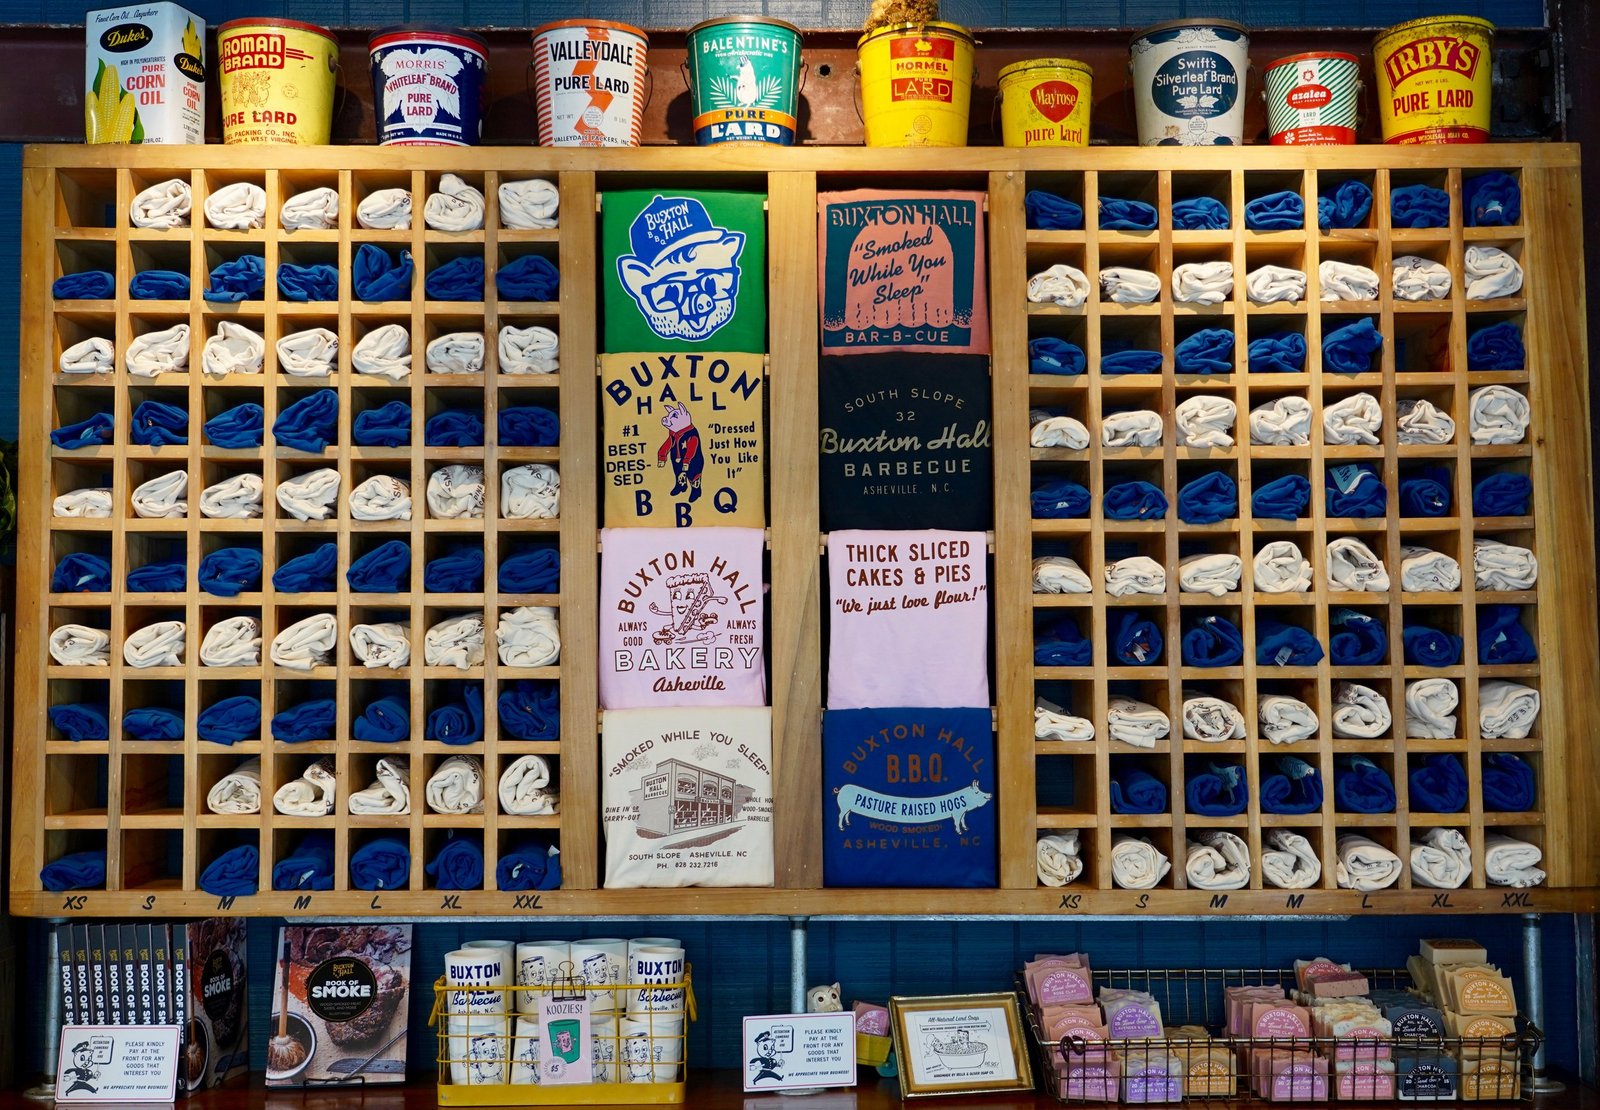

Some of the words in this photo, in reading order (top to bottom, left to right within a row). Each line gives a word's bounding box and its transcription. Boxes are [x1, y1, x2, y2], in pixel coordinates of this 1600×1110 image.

[107, 28, 146, 47] Duke's
[224, 36, 281, 58] ROMAN
[703, 36, 787, 54] BALENTINE'S
[550, 40, 632, 66] VALLEYDALE
[1388, 36, 1474, 82] IRBY'S
[142, 64, 165, 73] PURE
[224, 54, 281, 72] BRAND
[896, 62, 948, 71] HORMEL
[1178, 57, 1216, 70] Swift's
[126, 74, 165, 90] CORN
[430, 76, 457, 95] BRAND
[555, 76, 590, 91] PURE
[596, 76, 629, 94] LARD
[1210, 71, 1236, 86] Brand
[183, 87, 201, 103] CORN
[894, 81, 950, 96] LARD
[1172, 86, 1197, 96] Pure
[1200, 84, 1222, 94] Lard
[1292, 90, 1326, 101] azalea
[140, 90, 165, 106] OIL
[187, 99, 197, 111] OIL
[408, 93, 432, 103] PURE
[1036, 88, 1076, 108] Mayrose
[1393, 92, 1429, 117] PURE
[1437, 89, 1473, 108] LARD
[252, 110, 297, 125] LARD
[407, 106, 432, 116] LARD
[725, 110, 766, 119] PURE
[711, 122, 780, 139] LARD
[1025, 128, 1054, 146] pure
[1060, 125, 1082, 144] lard
[645, 201, 689, 231] BUXTON
[831, 205, 916, 227] BUXTON
[923, 205, 972, 226] HALL
[659, 216, 693, 239] HALL
[850, 258, 904, 287] While
[908, 254, 946, 277] You
[606, 355, 760, 406] BUXTON
[636, 383, 726, 415] HALL
[845, 388, 898, 412] SOUTH
[911, 388, 965, 409] SLOPE
[896, 411, 916, 422] 32
[622, 425, 640, 437] #1
[820, 428, 921, 454] Buxton
[927, 419, 991, 450] Hall
[608, 442, 646, 456] BEST
[709, 439, 730, 449] Just
[734, 438, 757, 449] How
[710, 454, 731, 465] You
[738, 452, 758, 463] Like
[606, 459, 651, 473] DRES-
[844, 459, 971, 477] BARBECUE
[614, 473, 644, 486] SED
[847, 544, 898, 562] THICK
[909, 540, 970, 562] SLICED
[847, 568, 903, 586] CAKES
[914, 567, 925, 585] &
[935, 564, 971, 583] PIES
[618, 551, 694, 613] BUXTON
[710, 556, 756, 614] HALL
[867, 597, 896, 615] just
[902, 595, 929, 609] love
[618, 622, 647, 632] ALWAYS
[727, 620, 756, 629] ALWAYS
[623, 636, 643, 646] GOOD
[730, 634, 753, 644] FRESH
[615, 647, 760, 672] BAKERY
[653, 675, 726, 692] Asheville
[661, 730, 700, 743] WHILE
[710, 732, 733, 746] YOU
[842, 723, 925, 775] BUXTON
[938, 728, 984, 773] HALL
[887, 753, 948, 783] B.B.Q.
[855, 794, 897, 815] PASTURE
[901, 803, 936, 816] RAISED
[940, 796, 967, 813] HOGS
[604, 814, 640, 822] CARRY-OUT
[869, 822, 897, 832] WOOD
[960, 837, 980, 846] NC
[63, 896, 87, 910] XS
[142, 896, 156, 910] S
[217, 895, 236, 910] M
[294, 896, 312, 910] M
[370, 896, 382, 909] L
[441, 895, 462, 909] XL
[513, 895, 544, 909] XXL
[1059, 894, 1082, 908] XS
[1136, 894, 1149, 908] S
[1210, 894, 1228, 908] M
[1286, 894, 1304, 908] M
[1362, 894, 1373, 908] L
[1432, 894, 1454, 908] XL
[1501, 894, 1534, 908] XXL
[451, 962, 500, 979] BUXTON
[638, 959, 682, 975] BUXTON
[62, 965, 71, 993] BOOK
[126, 964, 134, 992] BOOK
[204, 978, 231, 998] SMOKE
[312, 985, 371, 998] SMOKE
[65, 996, 72, 1009] OF
[127, 994, 135, 1008] OF
[176, 994, 183, 1008] OF
[546, 1004, 583, 1015] KOOZIES!
[1397, 1014, 1419, 1026] BUXTON
[1421, 1016, 1435, 1028] HALL
[551, 1064, 559, 1072] $5
